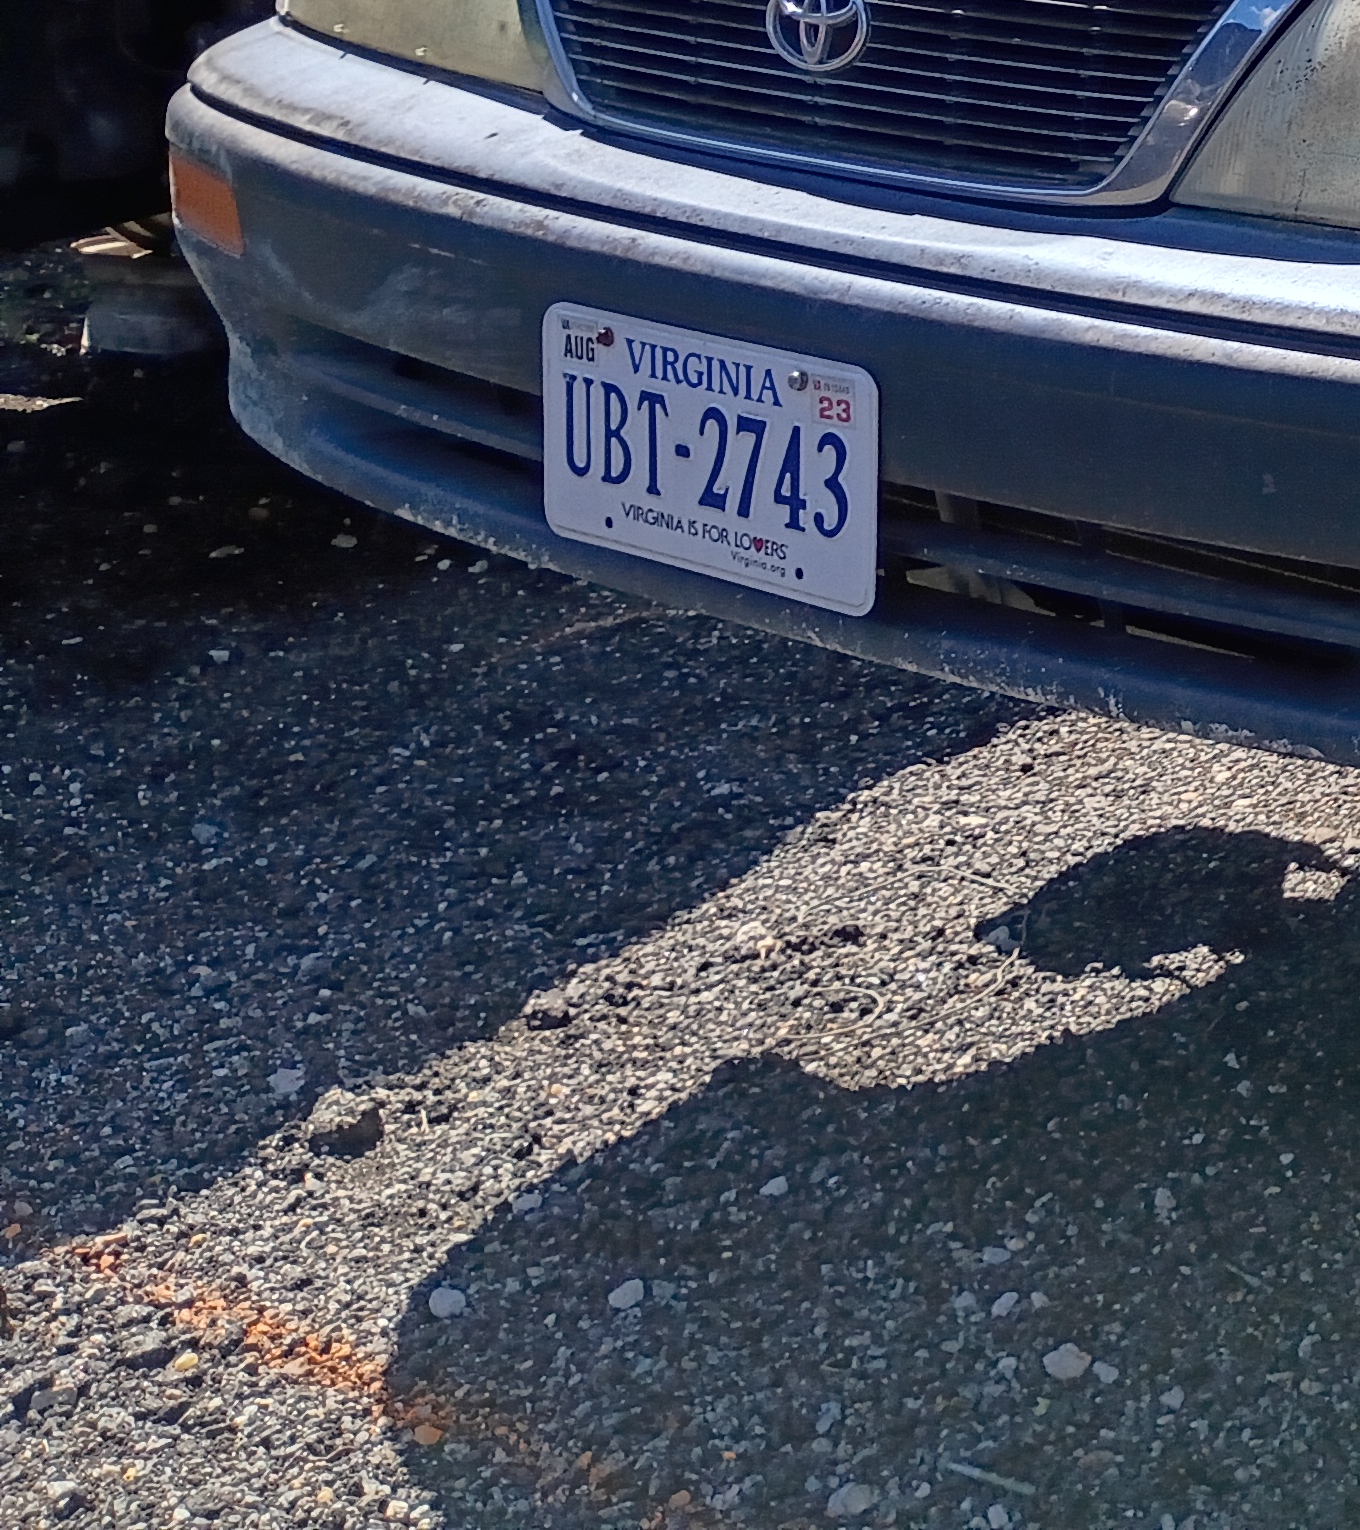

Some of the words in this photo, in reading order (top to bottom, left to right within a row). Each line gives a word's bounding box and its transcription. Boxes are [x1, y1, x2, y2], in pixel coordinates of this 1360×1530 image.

[563, 333, 595, 362] AUG
[624, 337, 782, 407] VIRGINIA
[818, 396, 851, 422] 23
[562, 372, 848, 538] UBT-2743
[621, 501, 684, 534] VIRGINIA
[688, 518, 698, 536] IS
[702, 523, 731, 546] FOR
[730, 550, 787, 578] Virginia.org
